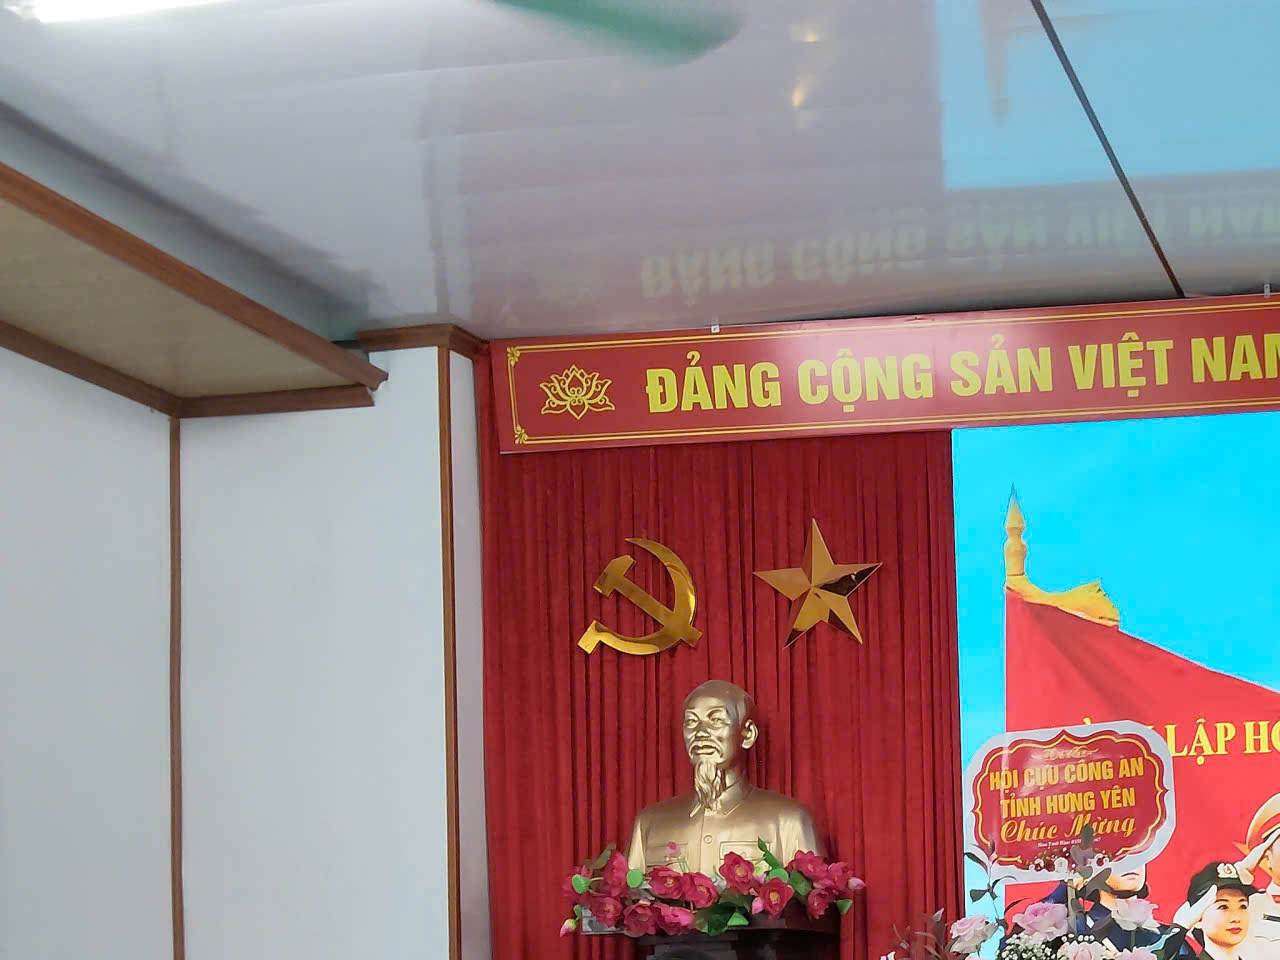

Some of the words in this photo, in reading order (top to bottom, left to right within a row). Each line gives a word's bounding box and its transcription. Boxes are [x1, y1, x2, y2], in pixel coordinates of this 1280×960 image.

[645, 351, 781, 413] ĐẢNG
[798, 348, 934, 413] CỘNG
[950, 333, 1053, 397] SẢN
[1068, 332, 1174, 397] VIỆT
[1165, 718, 1236, 765] LẬP
[989, 768, 1018, 794] HỘI
[1024, 765, 1060, 792] CỰU
[1063, 760, 1113, 784] CÔNG
[1000, 791, 1041, 819] TỈNH
[1046, 791, 1096, 815] HƯNG
[1100, 785, 1136, 809] YÊN
[1000, 818, 1059, 843] Chúc
